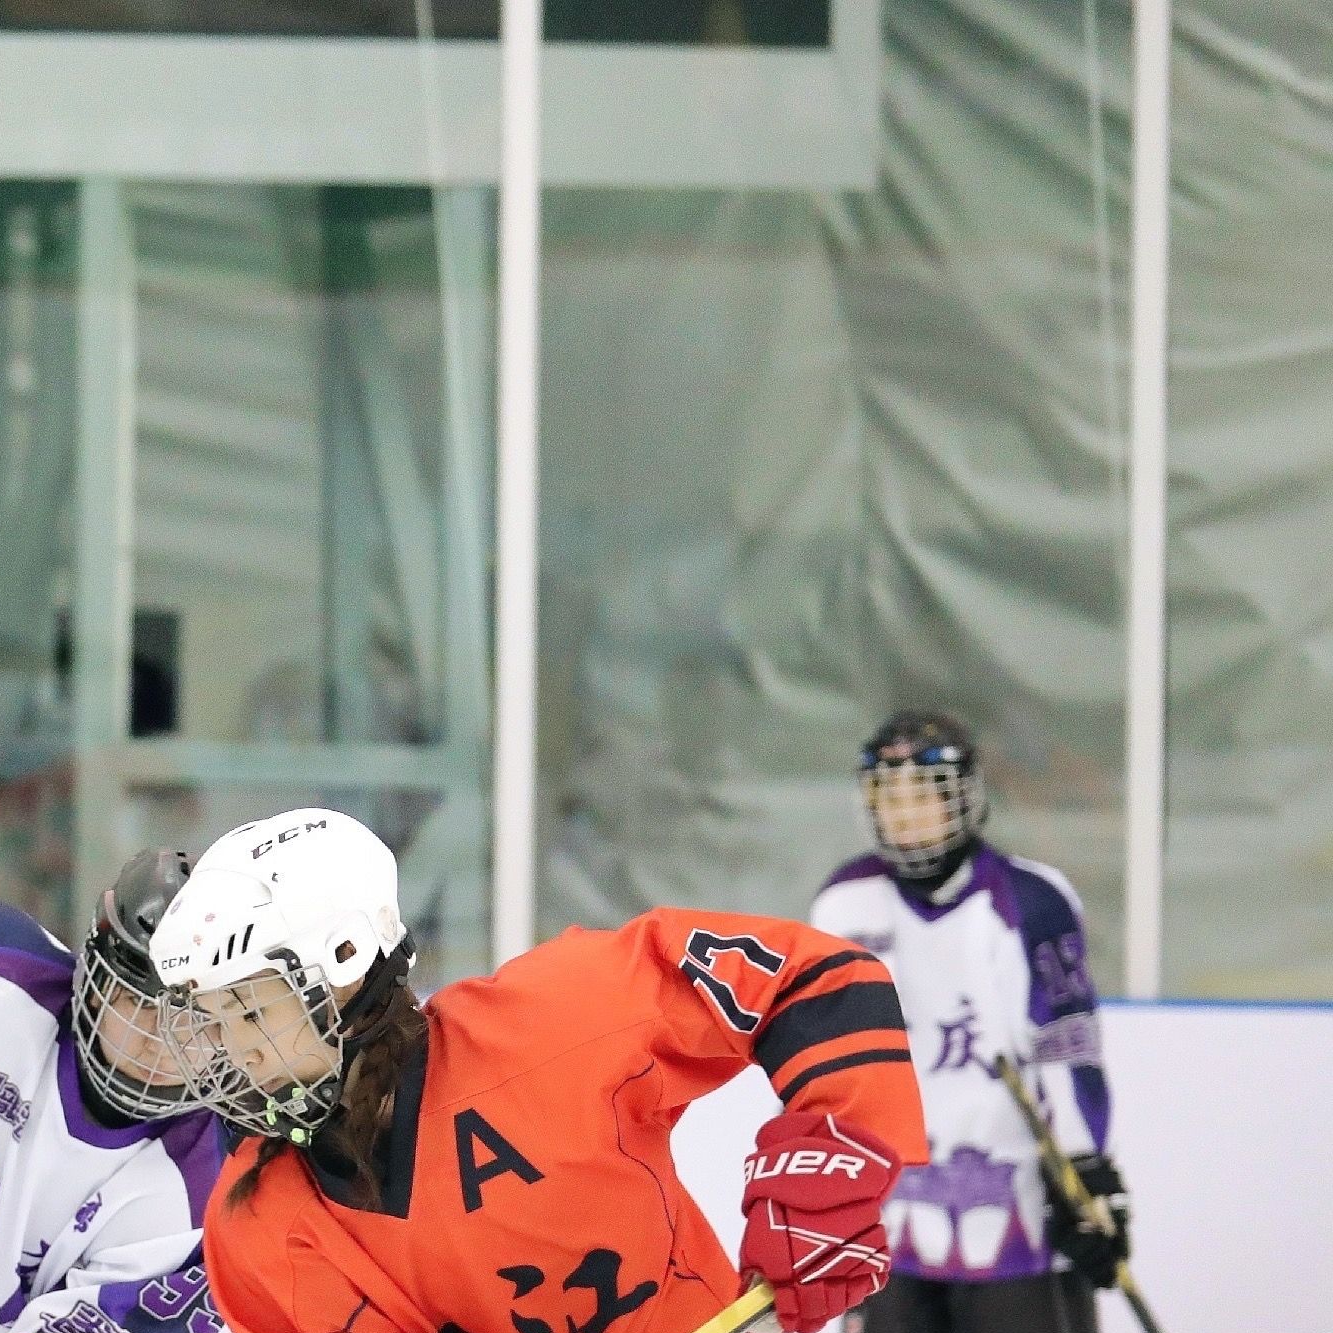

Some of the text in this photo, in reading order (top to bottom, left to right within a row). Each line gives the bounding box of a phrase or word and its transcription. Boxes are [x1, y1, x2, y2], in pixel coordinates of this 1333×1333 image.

[250, 818, 328, 859] CCM
[160, 954, 190, 971] CCM
[452, 1107, 546, 1214] A
